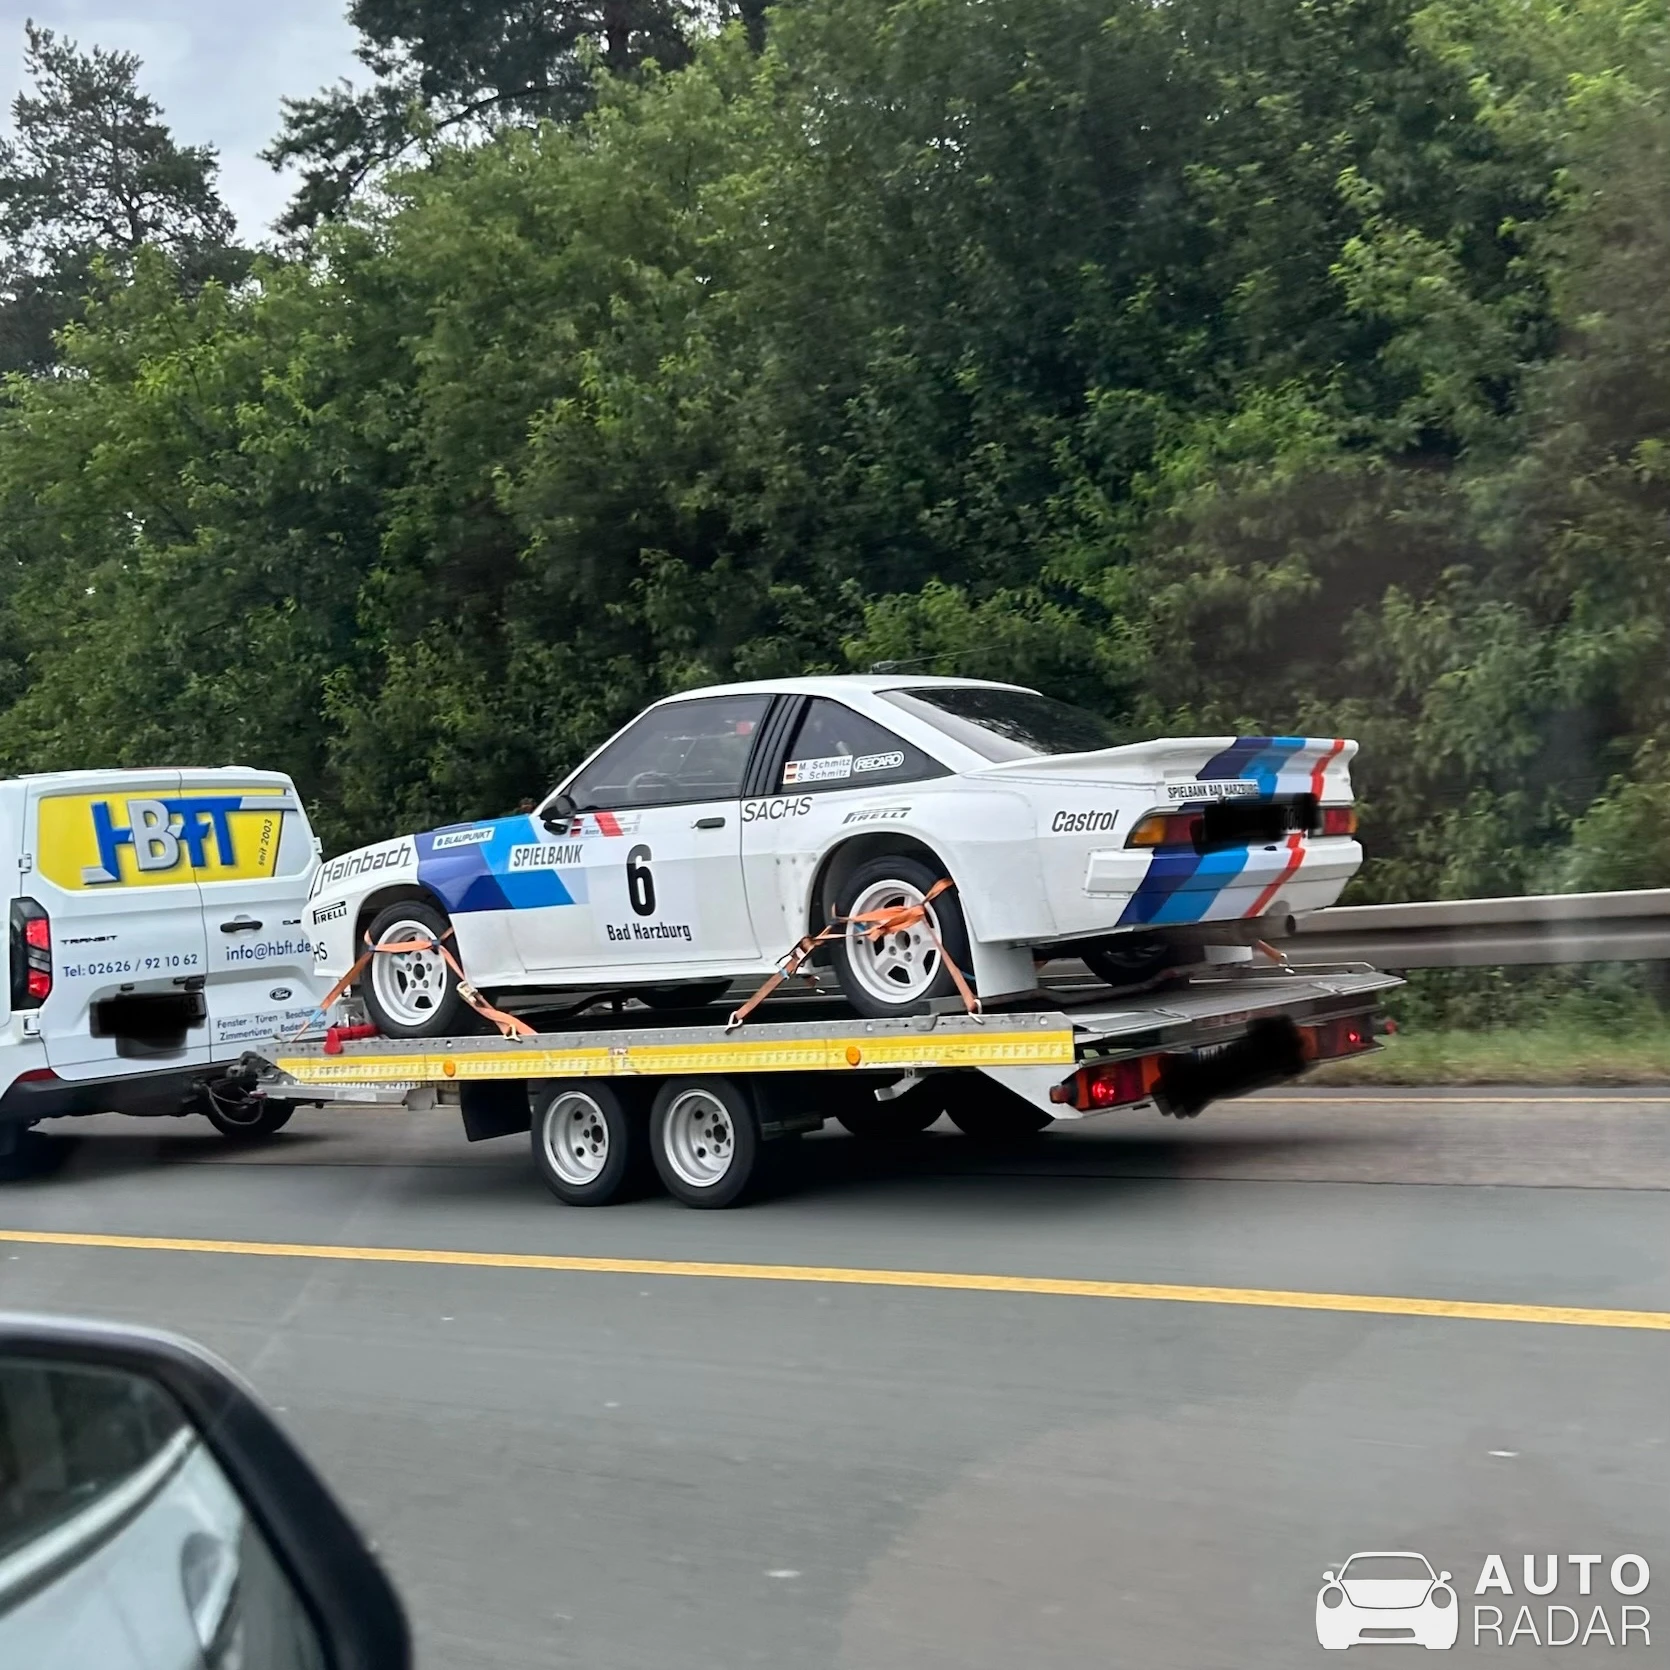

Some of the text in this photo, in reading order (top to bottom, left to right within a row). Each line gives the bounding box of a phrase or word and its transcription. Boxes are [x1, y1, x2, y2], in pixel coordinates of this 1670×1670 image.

[812, 759, 851, 770] Schmitz
[856, 753, 902, 771] RECARO
[809, 769, 847, 779] Schmitz
[1168, 784, 1208, 799] SPIELBANK
[1209, 784, 1223, 796] BAD
[743, 797, 813, 823] SACHS
[842, 807, 912, 824] PIRELLI
[1052, 809, 1119, 832] Castrol
[258, 818, 273, 866] seit 2003
[444, 830, 492, 845] BLAUPUNKT
[513, 844, 583, 867] SPIELBANK
[314, 843, 412, 897] Hainbach
[626, 844, 656, 916] 6
[313, 901, 347, 925] PIRELLI
[60, 935, 118, 945] TRANSIT
[606, 922, 692, 941] Bad Harzburg
[226, 939, 312, 961] info@hbft.de
[145, 957, 160, 969] 92
[166, 955, 180, 967] 10
[183, 953, 198, 965] 62
[217, 1018, 247, 1029] Fenster
[256, 1014, 278, 1025] Türen
[220, 1028, 272, 1041] Zimmertüren
